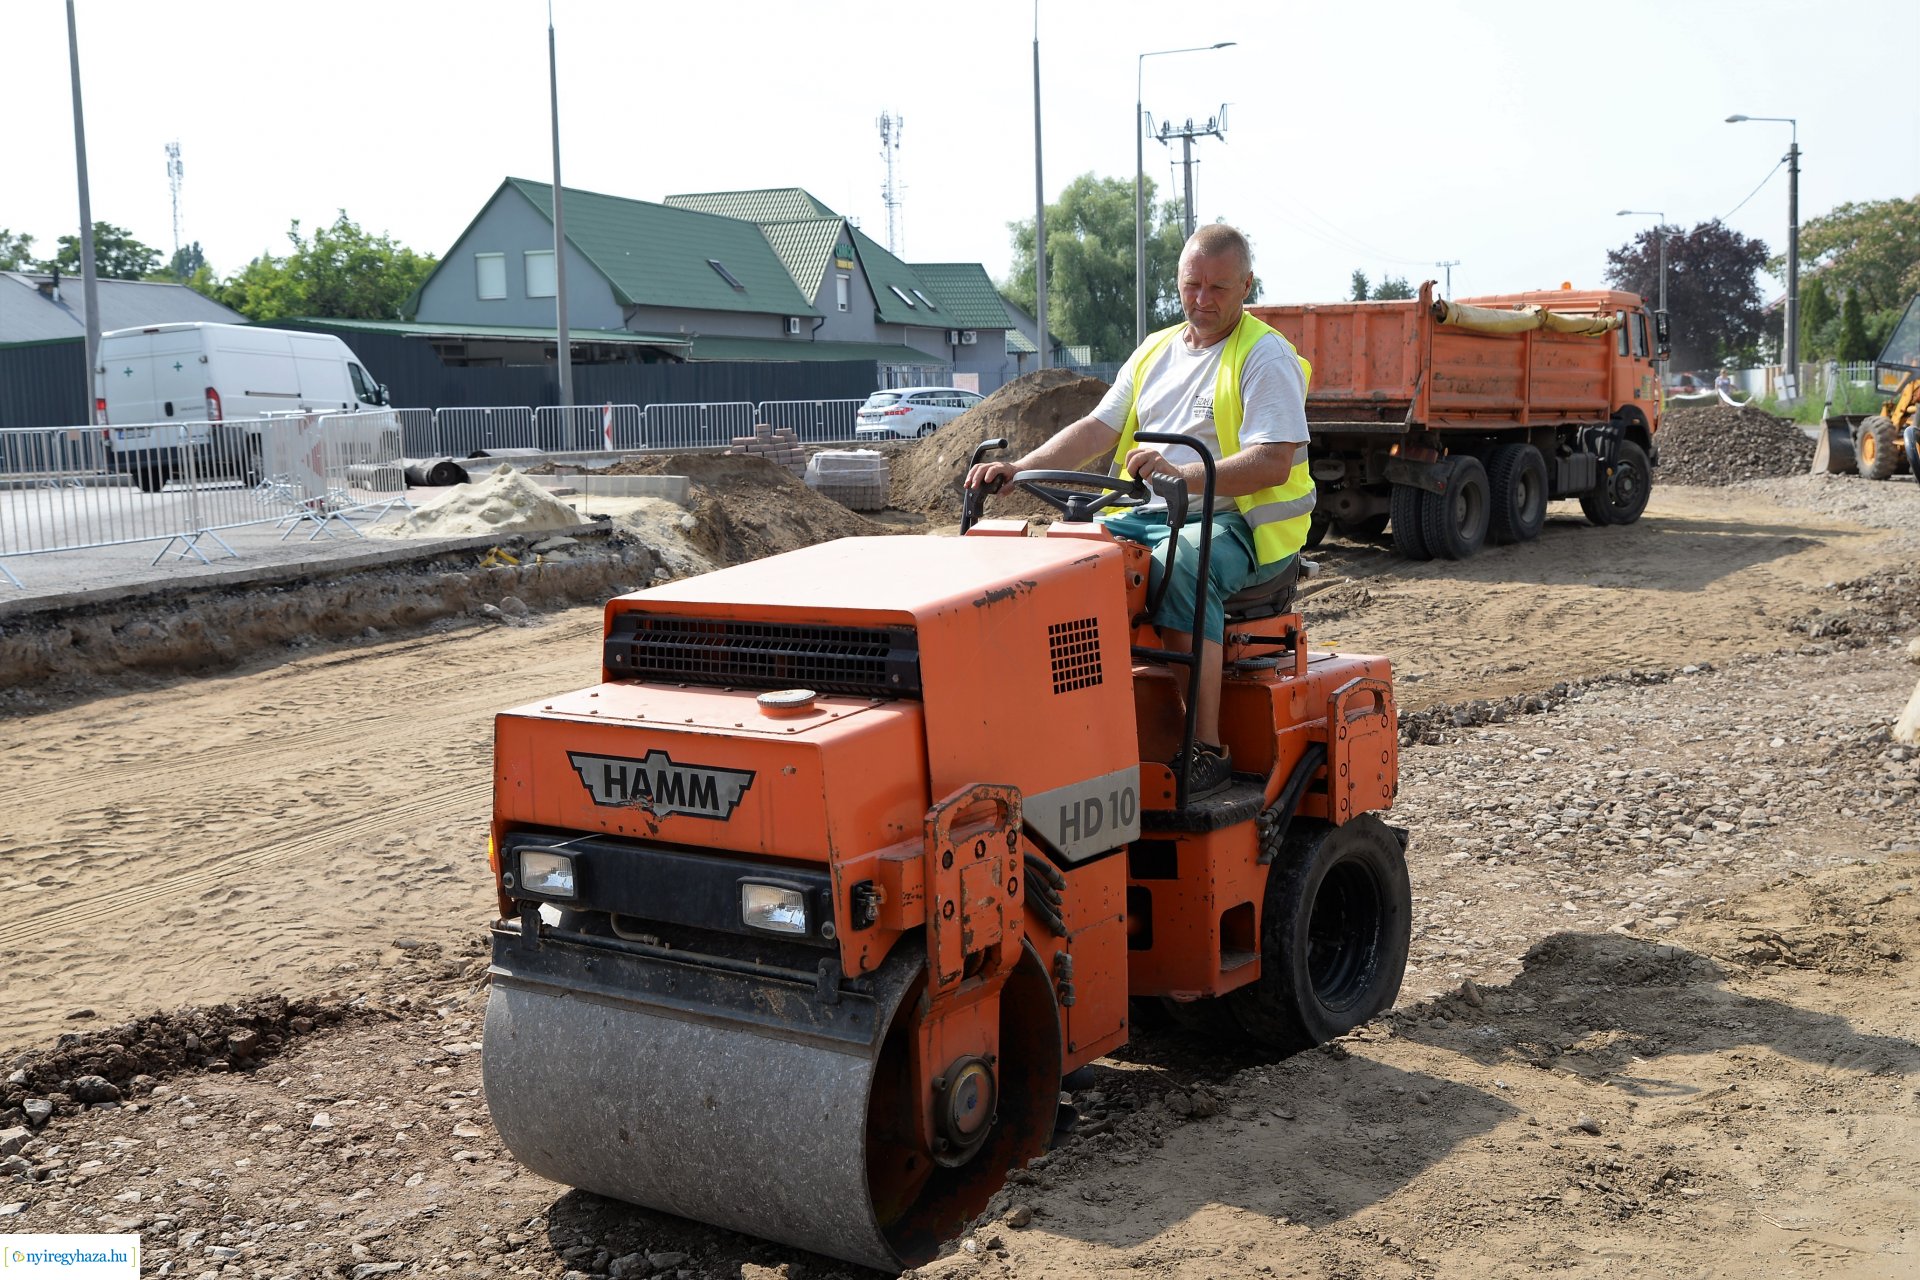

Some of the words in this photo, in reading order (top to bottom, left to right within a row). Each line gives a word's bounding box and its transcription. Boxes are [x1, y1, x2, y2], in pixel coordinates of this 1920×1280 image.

[603, 764, 720, 811] HAMM
[1060, 797, 1104, 846] HD
[1108, 786, 1136, 830] 10
